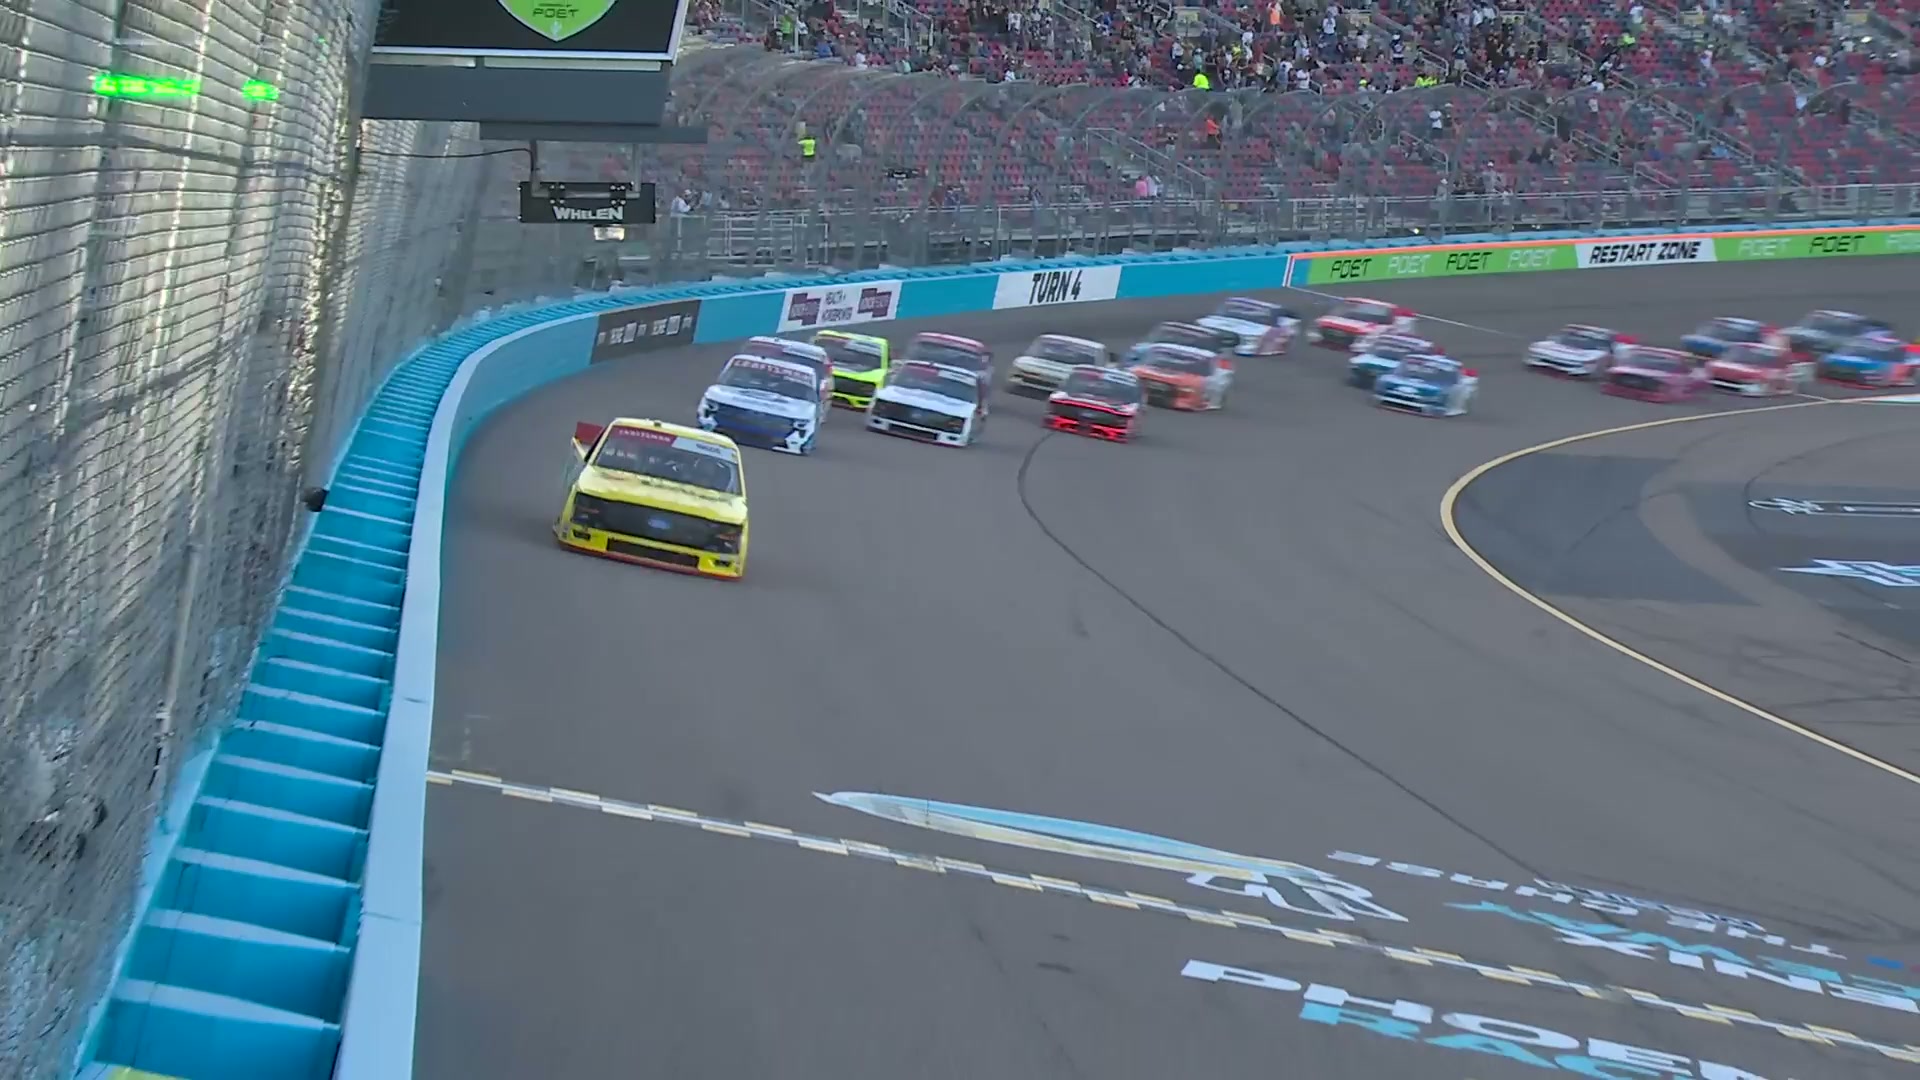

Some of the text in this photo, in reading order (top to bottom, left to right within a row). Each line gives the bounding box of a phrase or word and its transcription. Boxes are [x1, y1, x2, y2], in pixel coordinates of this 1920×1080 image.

[533, 8, 579, 18] POET
[553, 206, 624, 221] WHELEN
[1589, 240, 1701, 264] RESTART ZONE
[1738, 238, 1792, 256] POET
[1808, 235, 1866, 254] POET
[1387, 254, 1432, 275] POET
[1446, 251, 1493, 271] POET
[1507, 248, 1556, 268] POET
[1330, 258, 1373, 279] POET
[1029, 269, 1083, 305] TURN 4
[1300, 1001, 1694, 1080] RAC
